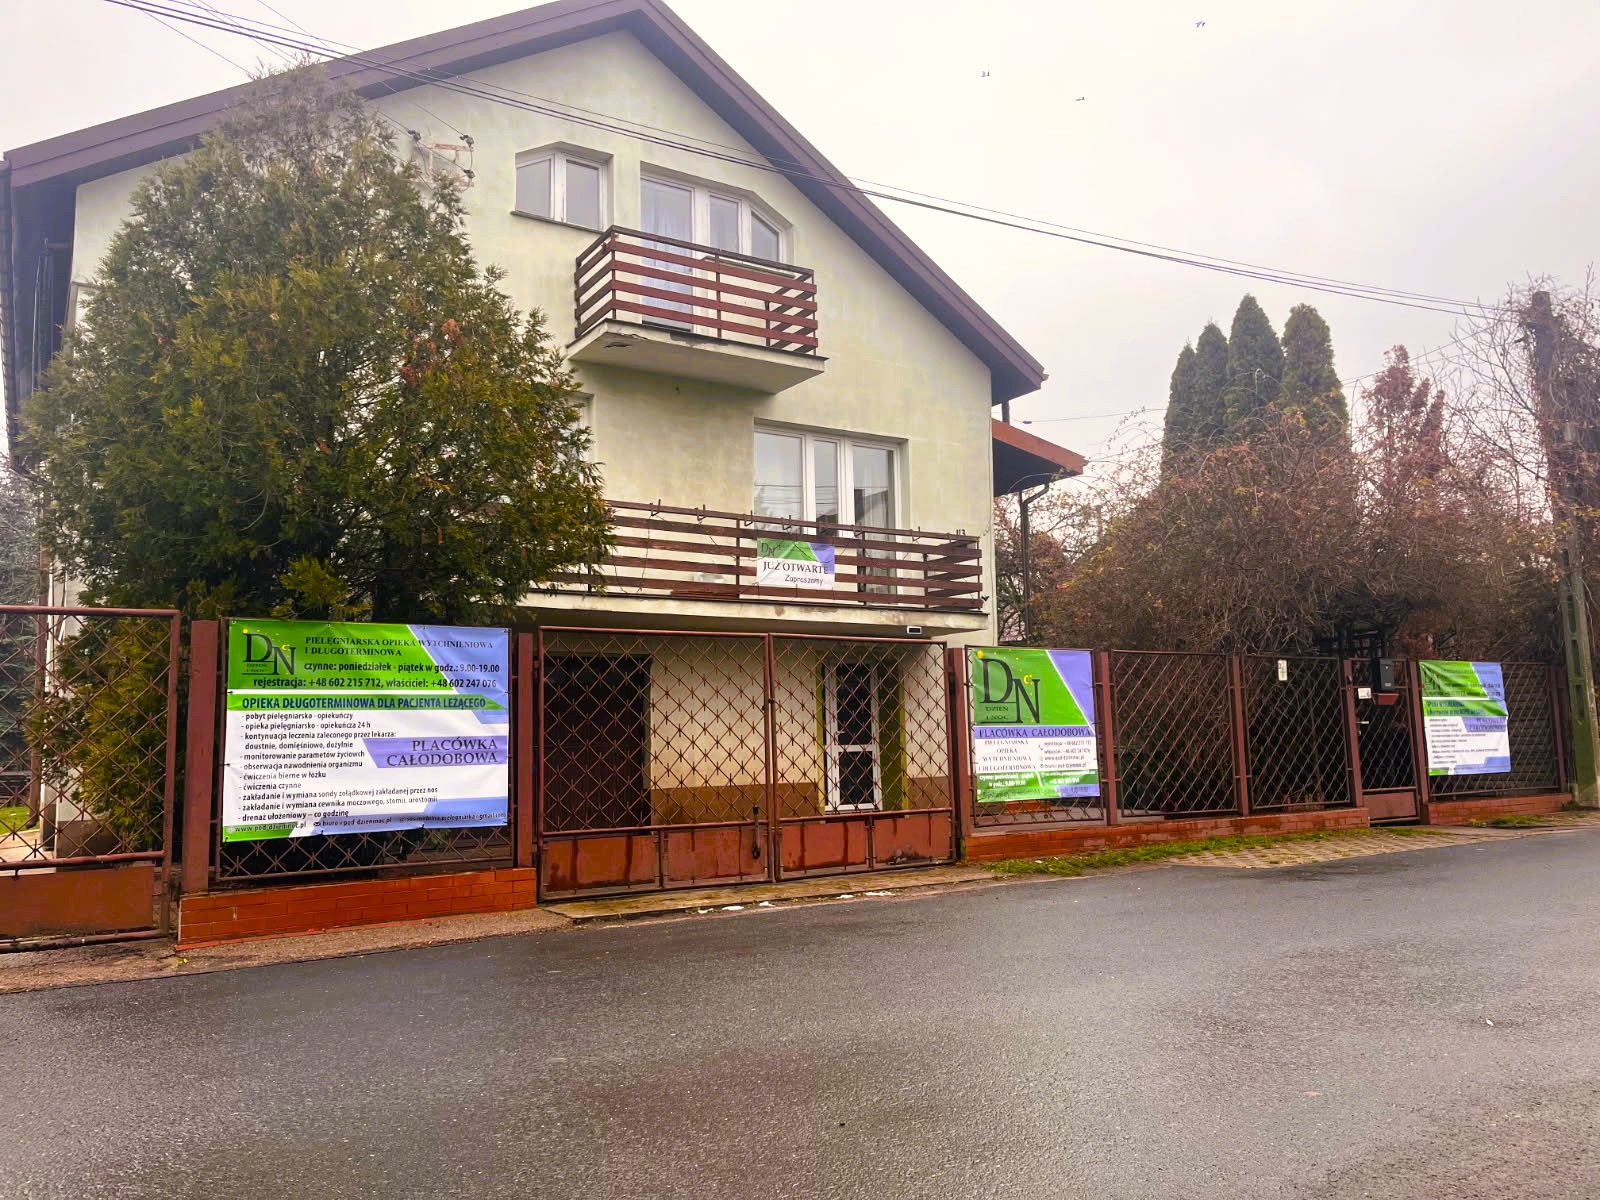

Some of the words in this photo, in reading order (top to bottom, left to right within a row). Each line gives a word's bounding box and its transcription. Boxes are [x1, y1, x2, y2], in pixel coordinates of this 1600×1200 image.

[763, 559, 780, 572] JUŻ
[782, 562, 829, 575] OTWARTE
[305, 636, 380, 647] PIELĘGNIARSKA
[382, 638, 416, 647] OPIEKA
[418, 639, 493, 649] WYTCHNIENIOWA
[311, 647, 402, 657] DŁUGOTERMINOWA
[304, 663, 337, 673] czynne:
[338, 662, 392, 673] poniedziałek
[397, 663, 424, 674] piątek
[434, 663, 459, 674] godz.:
[460, 664, 500, 673] 9.00-19.00
[253, 677, 306, 688] rejestracja:
[308, 677, 327, 687] +48
[329, 678, 344, 687] 602
[346, 678, 363, 687] 215
[365, 678, 384, 689] 712,
[386, 679, 428, 688] właściciel:
[431, 679, 447, 688] +48
[449, 679, 464, 688] 602
[466, 679, 482, 688] 247
[242, 697, 280, 709] OPIEKA
[282, 698, 374, 709] DŁUGOTERMINOWA
[378, 697, 396, 708] DLA
[398, 697, 440, 708] PACJENTA
[443, 696, 486, 710] LEŻĄCEGO
[245, 712, 266, 721] pobyt
[267, 712, 312, 721] pielęgniarsko
[317, 711, 353, 720] opiekuńczy
[245, 722, 269, 731] opieka
[270, 721, 315, 731] pielęgniarsko
[320, 721, 356, 730] opiekuńcza
[357, 721, 366, 729] 24
[245, 731, 287, 741] kontynuacja
[288, 731, 315, 739] leczenia
[317, 731, 353, 739] zaleconego
[353, 731, 370, 739] przez
[371, 730, 396, 738] lekarza:
[979, 727, 1028, 738] PLACÓWKA
[1031, 727, 1092, 738] CAŁODOBOWA
[411, 736, 498, 752] PLACÓWKA
[243, 752, 297, 760] monitorowanie
[386, 751, 499, 767] CAŁODOBOWA
[243, 762, 283, 771] obserwacja
[283, 761, 327, 769] nawodnienia
[328, 760, 363, 769] organizmu
[278, 771, 301, 779] bierne
[278, 782, 302, 791] czynne
[242, 792, 281, 801] zakładanie
[285, 791, 317, 800] wymiana
[318, 790, 338, 798] sondy
[409, 787, 426, 795] przez
[242, 802, 281, 811] zakładanie
[285, 801, 317, 810] wymiana
[318, 799, 345, 807] cewnika
